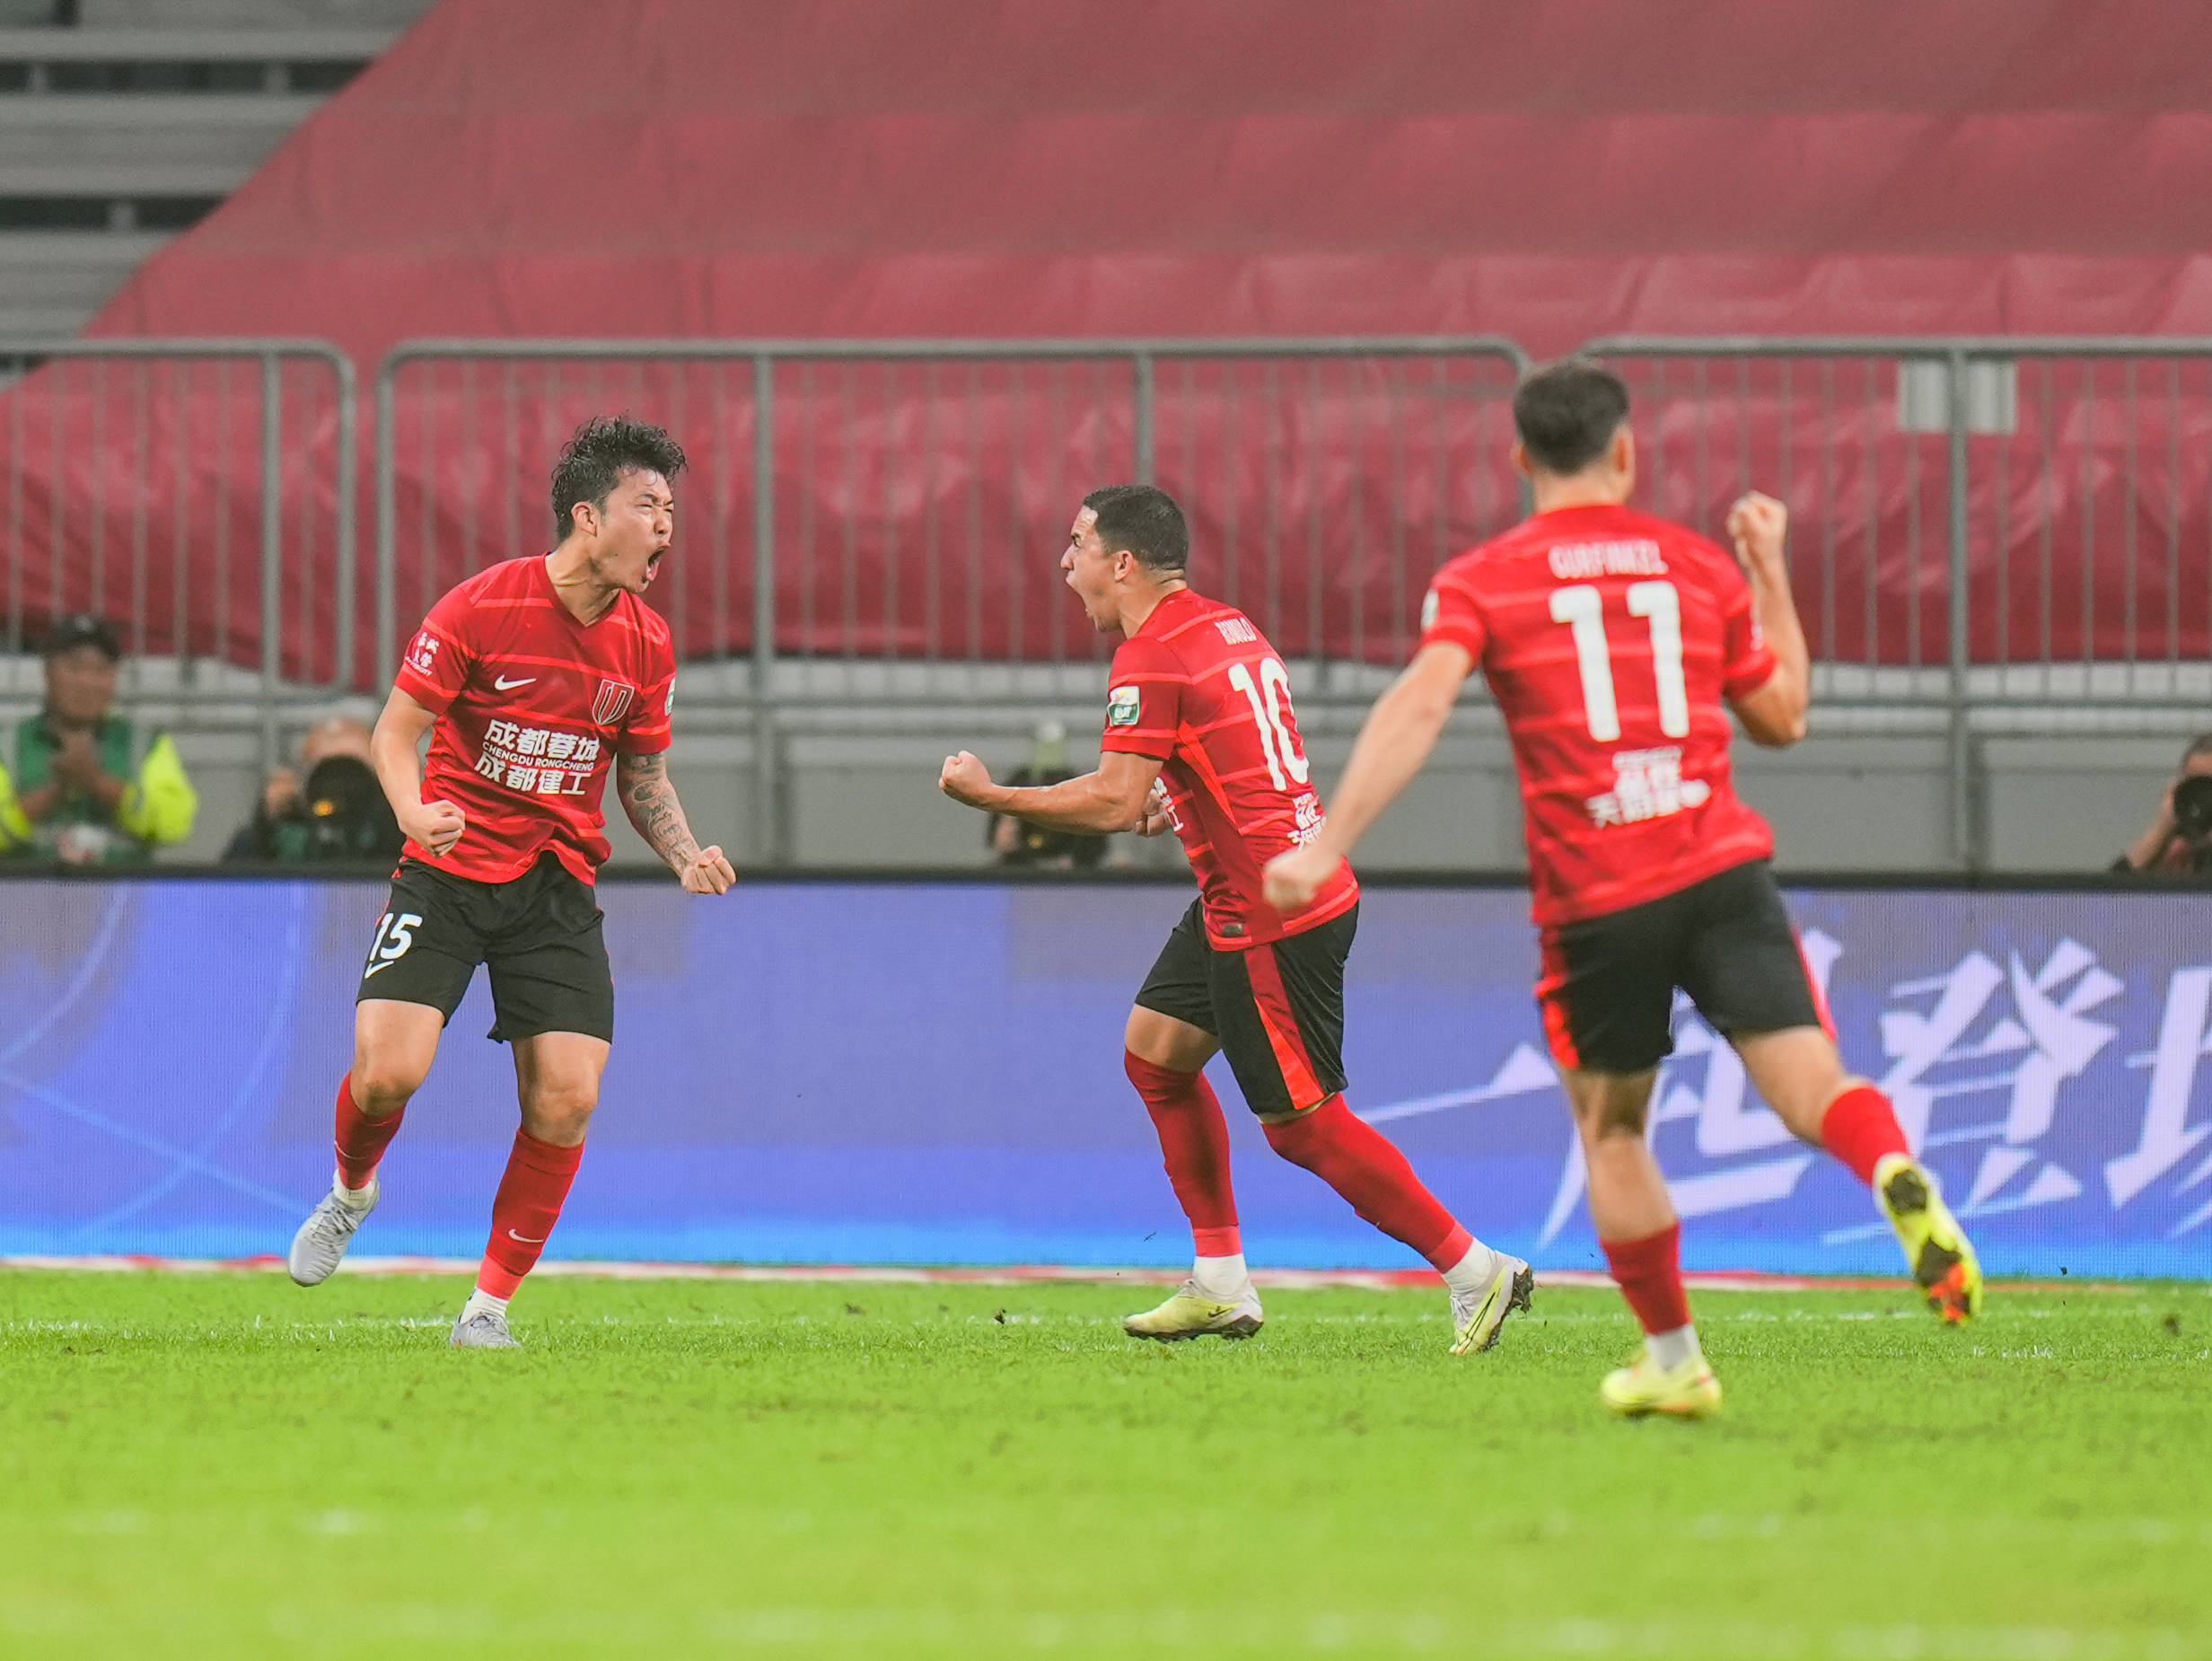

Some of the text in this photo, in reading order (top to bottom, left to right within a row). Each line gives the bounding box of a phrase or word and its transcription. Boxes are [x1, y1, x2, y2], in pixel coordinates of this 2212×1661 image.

[1549, 580, 1689, 743] 11
[484, 719, 600, 761] 成都蓉城
[1228, 657, 1309, 791] 10
[475, 751, 592, 795] 成都建工
[482, 741, 594, 772] CHENGDU RONGCHENG
[369, 912, 423, 962] 15
